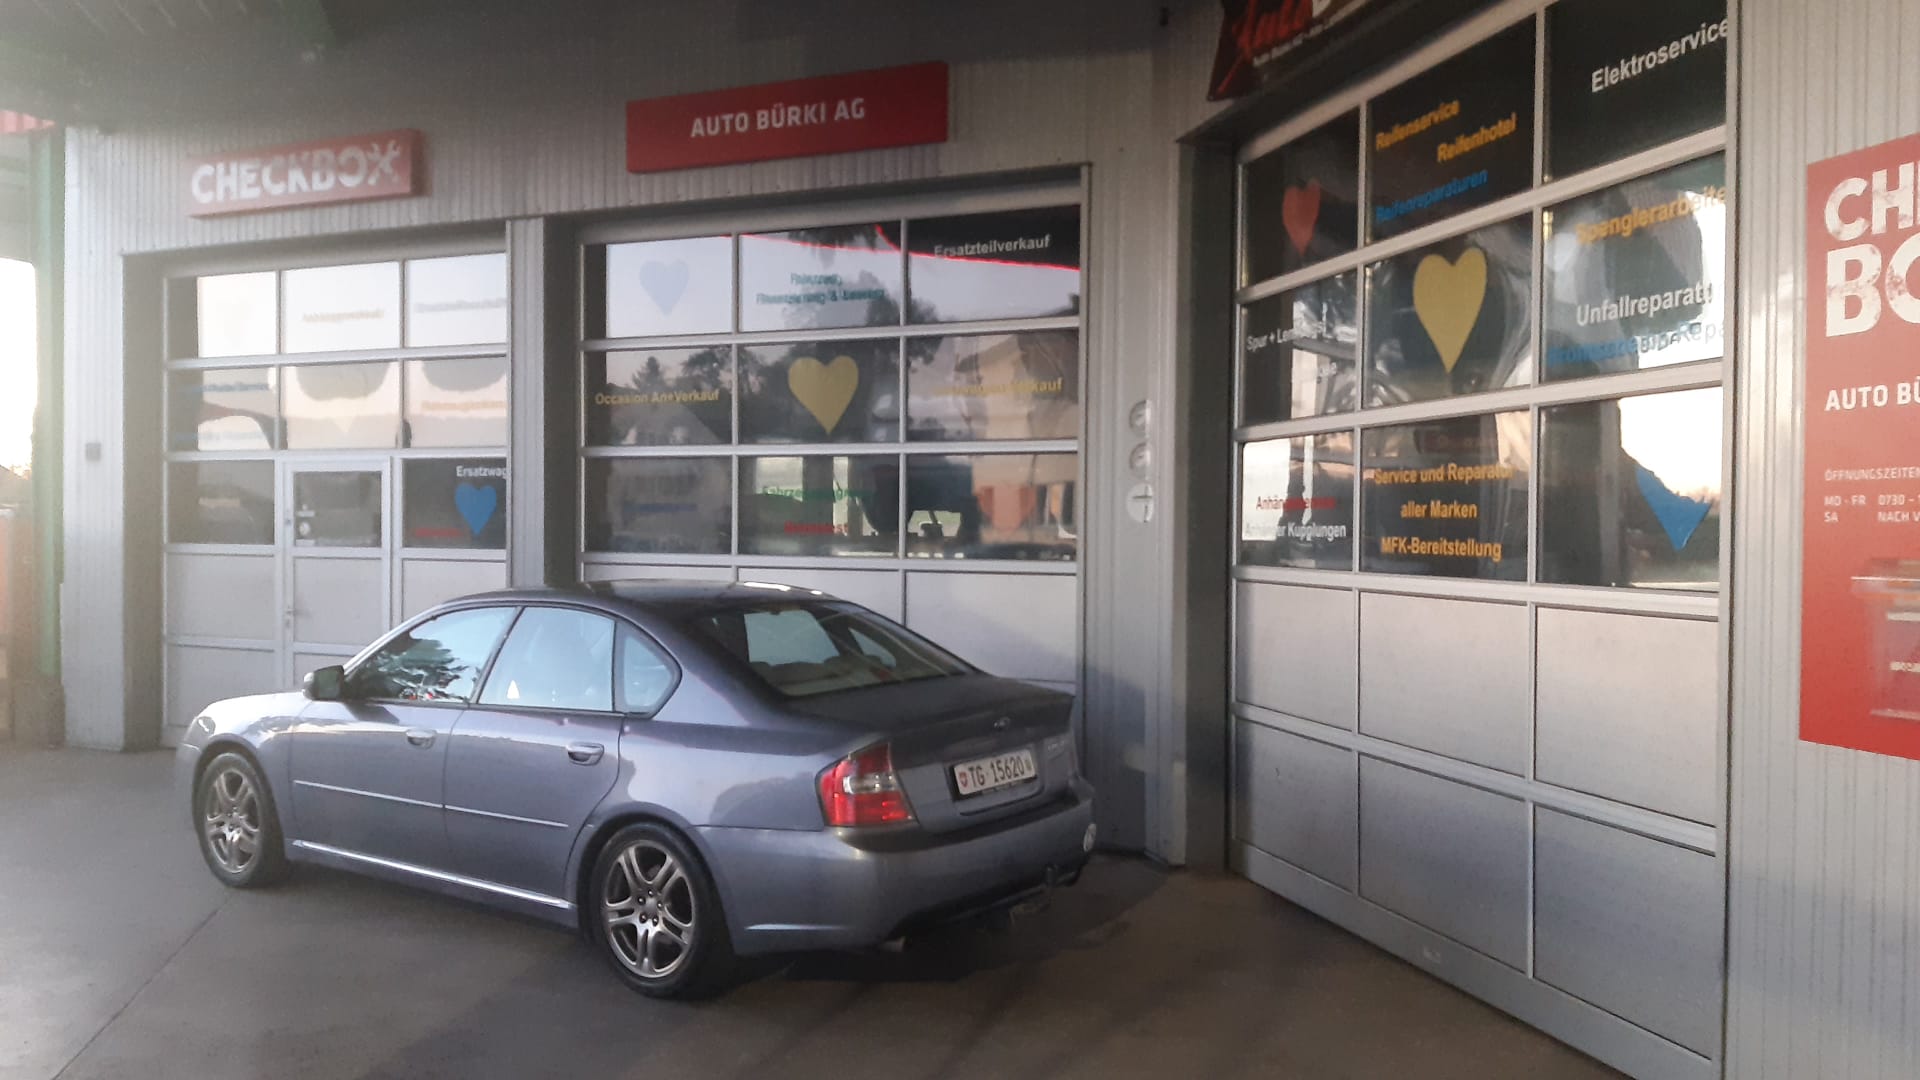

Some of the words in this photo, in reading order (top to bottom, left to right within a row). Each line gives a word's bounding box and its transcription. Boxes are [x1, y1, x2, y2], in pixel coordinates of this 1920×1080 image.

[1591, 18, 1728, 93] Elektroservice
[691, 112, 749, 138] AUTO
[756, 102, 826, 131] BÜRKI
[834, 98, 865, 121] AG
[191, 140, 401, 204] CHECKBOX
[1825, 161, 1920, 241] CH
[934, 235, 1051, 258] Ersatzteilverkauf
[1824, 384, 1888, 411] AUTO
[1374, 468, 1417, 485] Service
[1420, 464, 1445, 482] und
[1401, 501, 1427, 518] aller
[1430, 500, 1477, 518] Marken
[1851, 494, 1866, 505] FR
[1824, 511, 1839, 522] SA
[1877, 511, 1910, 522] NACH
[1288, 522, 1347, 541] Kupplungen
[1381, 536, 1503, 562] MFK-Bereitstellung
[968, 765, 985, 788] TG
[990, 755, 1026, 783] 15620
